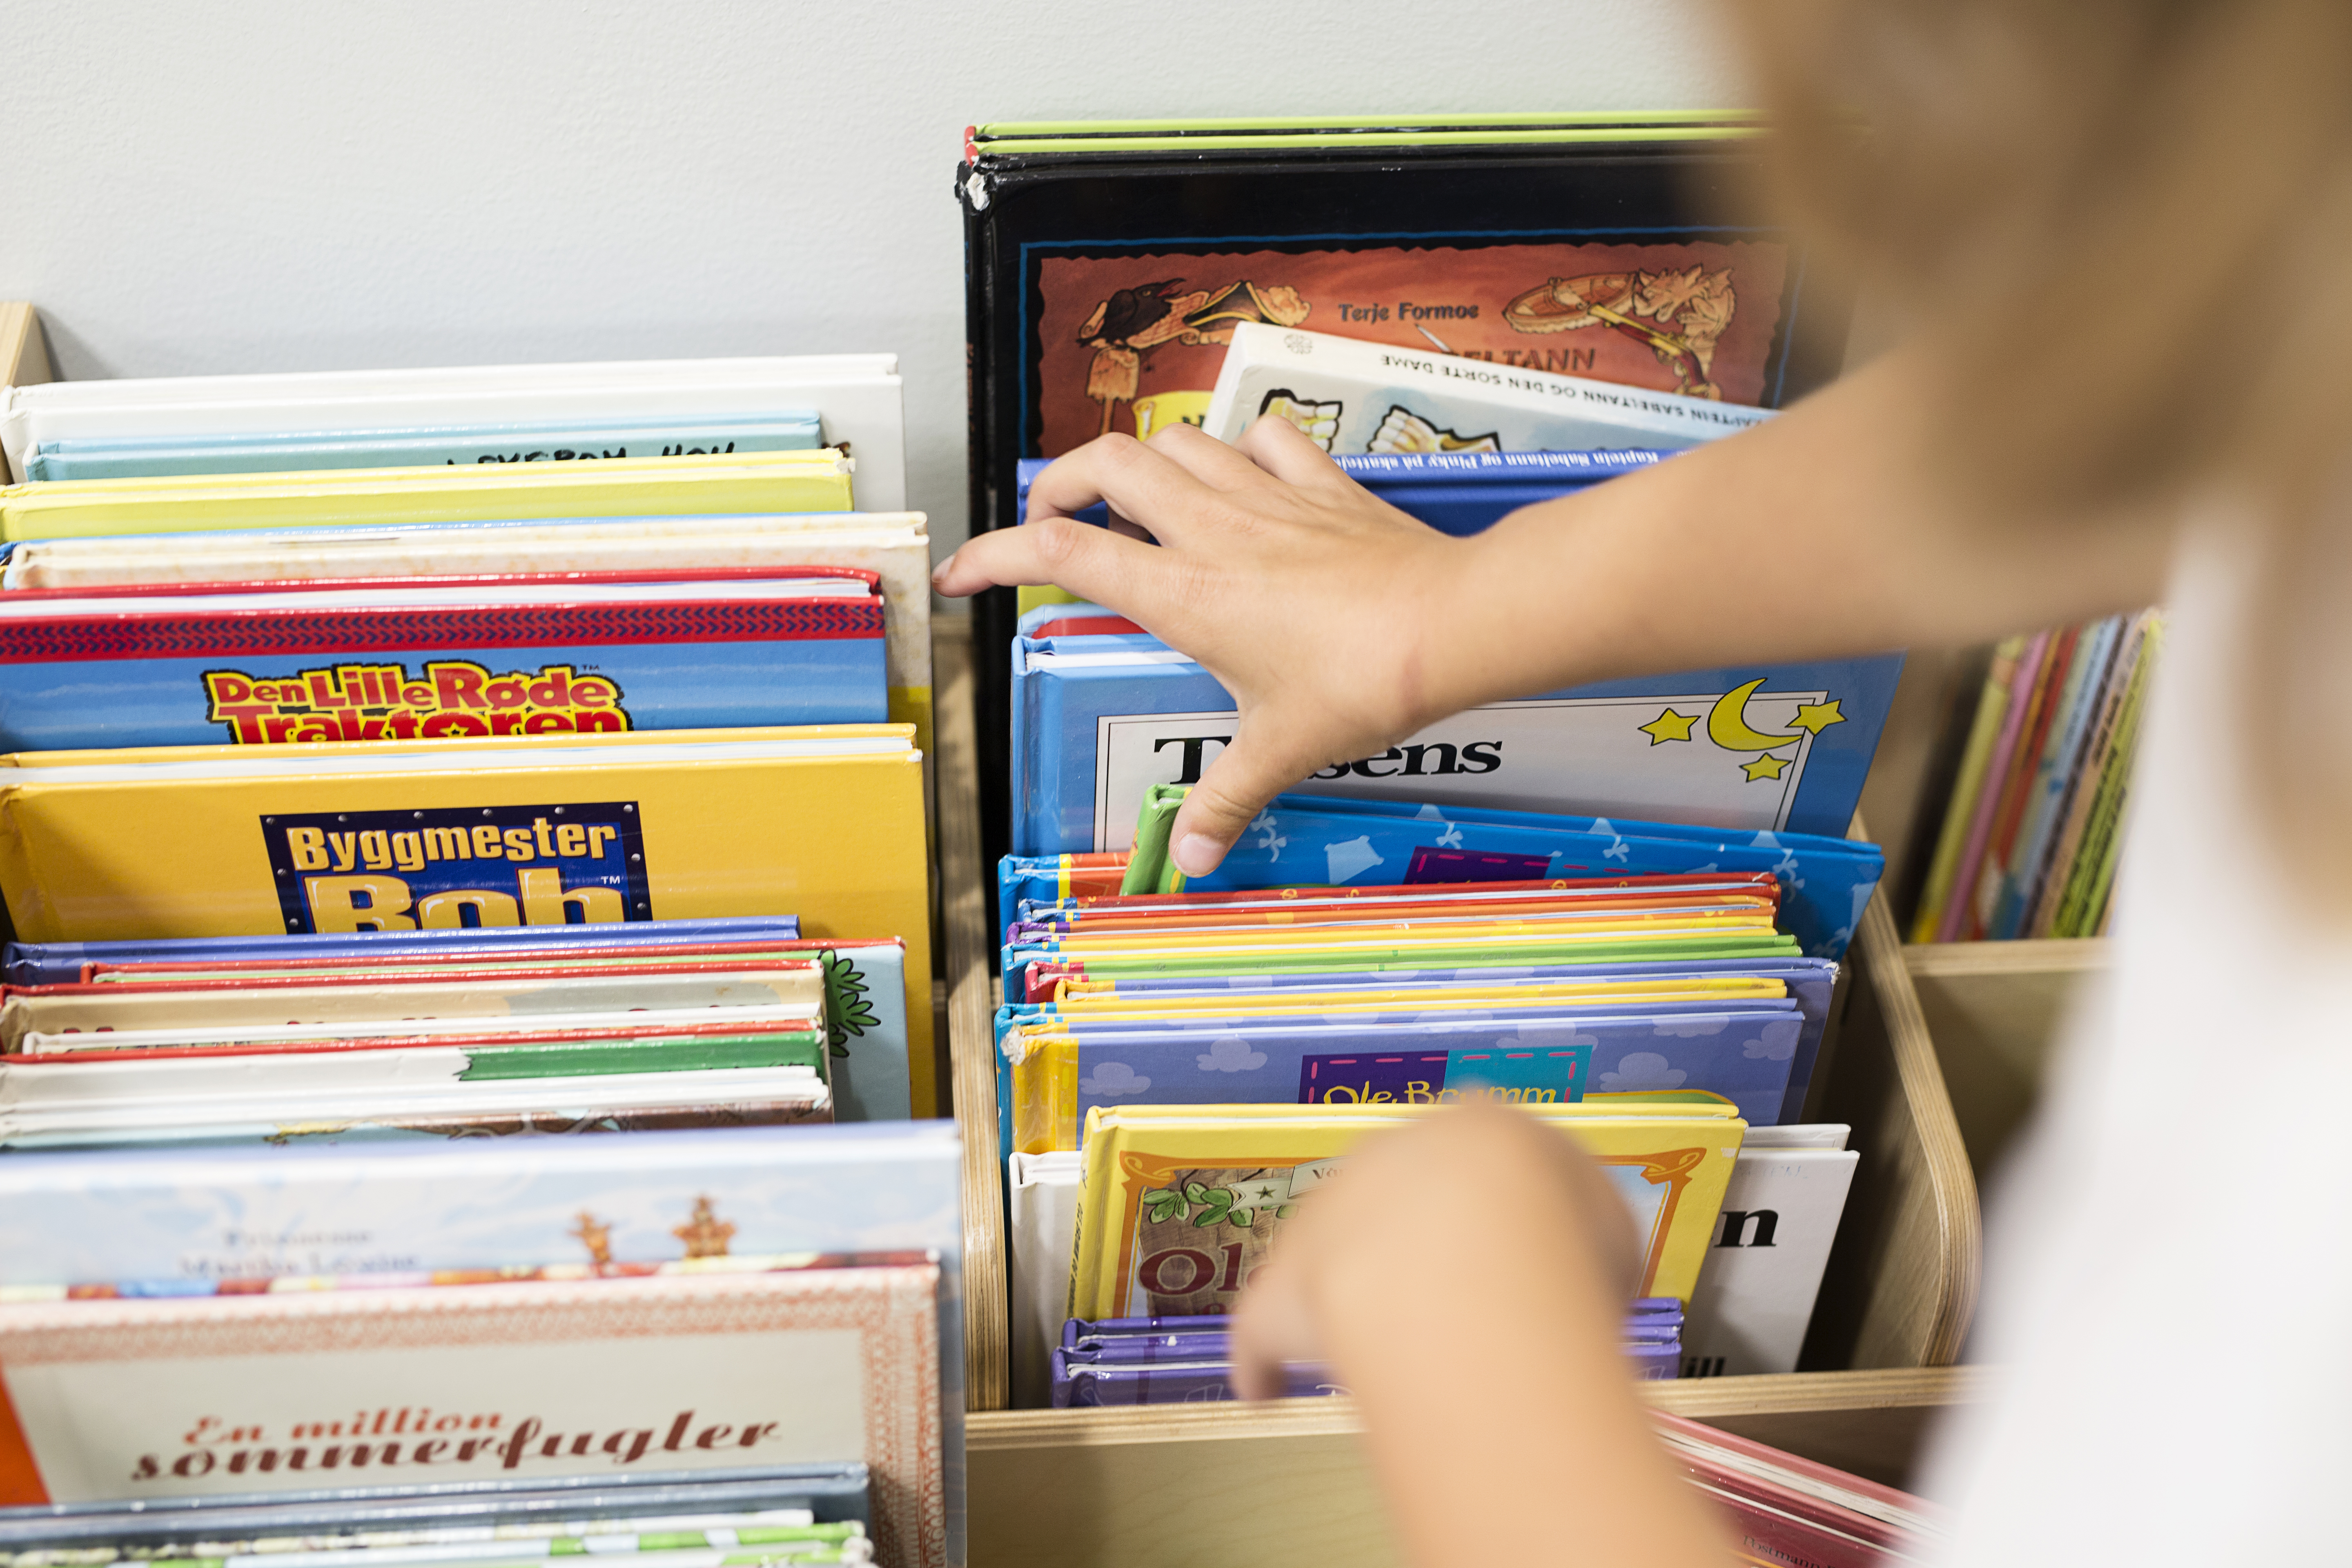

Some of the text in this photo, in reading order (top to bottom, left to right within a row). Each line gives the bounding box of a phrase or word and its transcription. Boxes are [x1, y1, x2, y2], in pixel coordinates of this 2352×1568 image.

[1338, 301, 1479, 325] Terje Formoe
[1380, 354, 1433, 374] DAME
[1441, 365, 1501, 385] SORTE
[1508, 377, 1544, 393] DEN
[1550, 384, 1576, 398] OG
[1584, 390, 1684, 416] SABELTANN
[1402, 454, 1424, 471] på
[1428, 453, 1478, 470] Pinky
[1480, 453, 1502, 467] og
[1505, 453, 1590, 468] Sabeltann
[1593, 450, 1659, 467] Kaptein
[211, 675, 308, 704] Den
[309, 670, 434, 708] Lille
[433, 667, 612, 710] Røde
[217, 705, 622, 743] Traktoren
[286, 817, 616, 872] Byggmester
[1323, 1080, 1393, 1104] Ole
[183, 1406, 506, 1446] En million
[131, 1409, 782, 1481] sommerfugler
